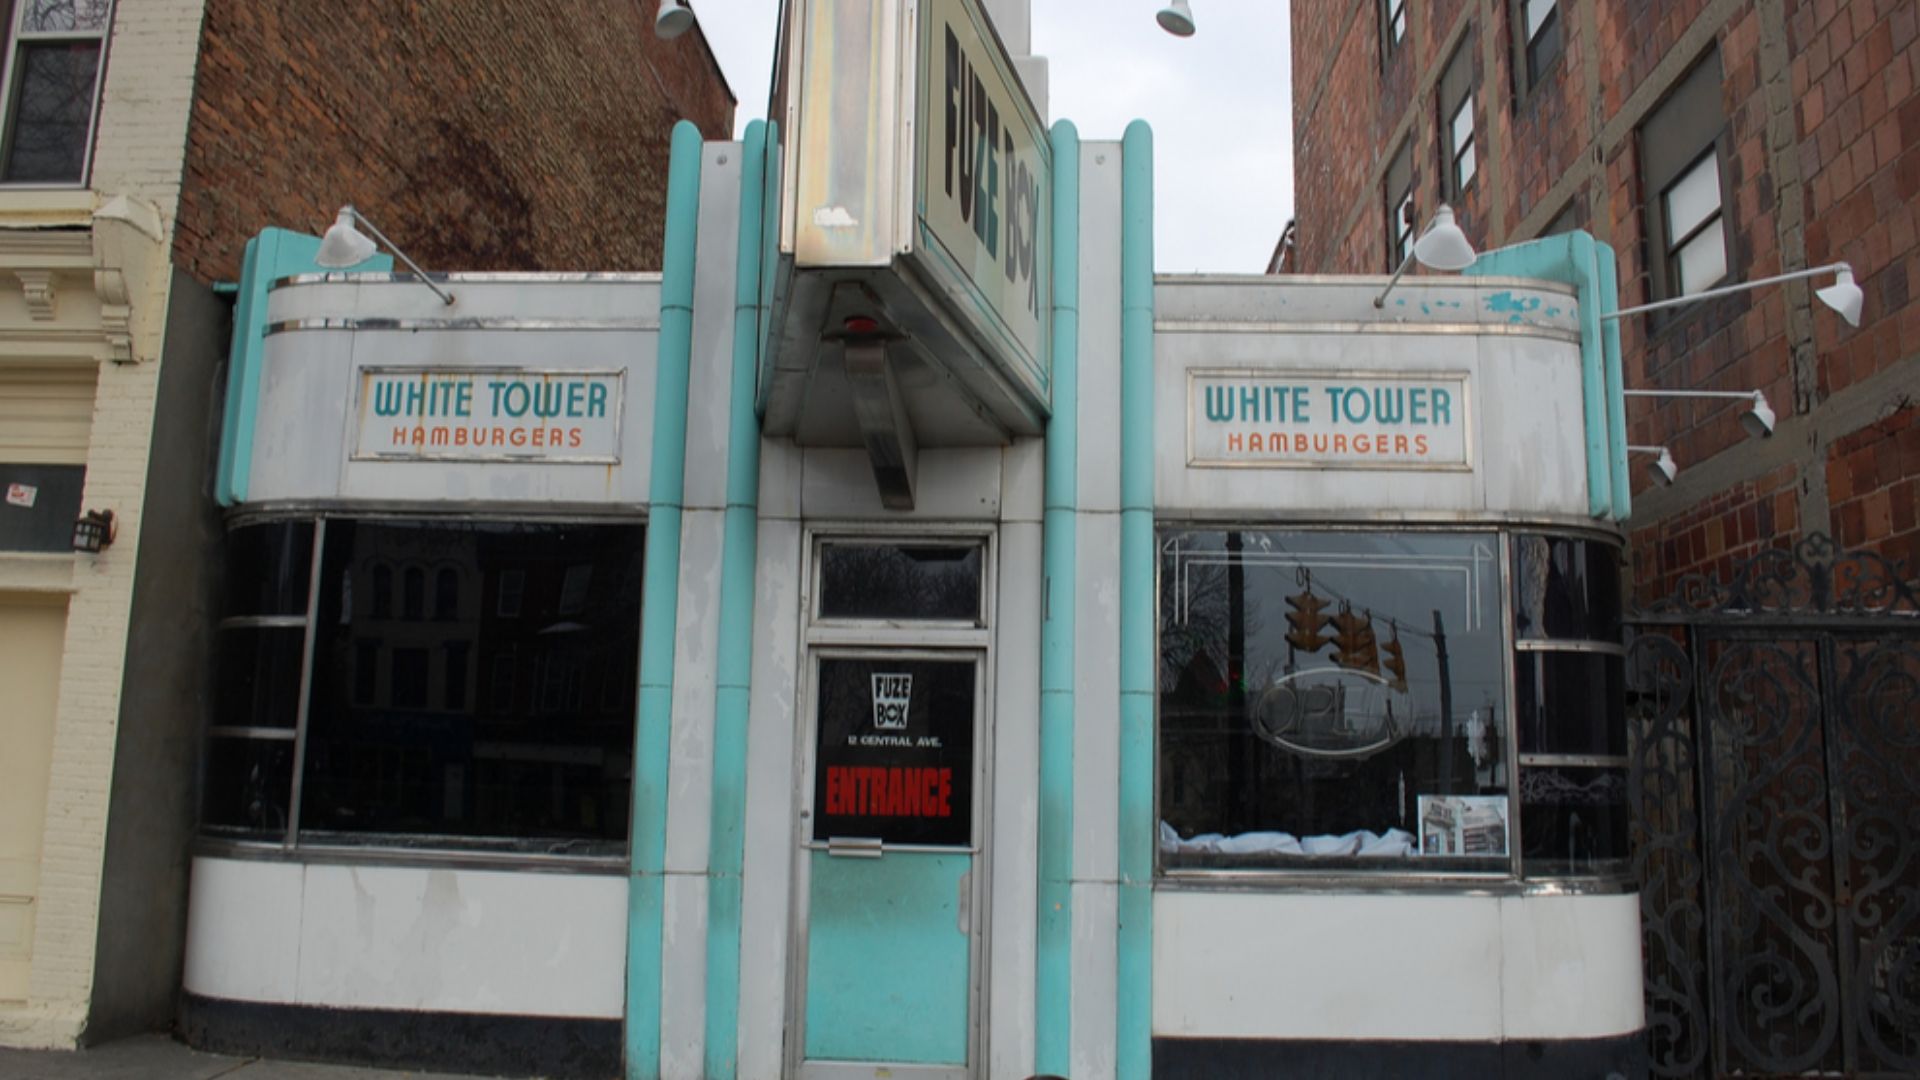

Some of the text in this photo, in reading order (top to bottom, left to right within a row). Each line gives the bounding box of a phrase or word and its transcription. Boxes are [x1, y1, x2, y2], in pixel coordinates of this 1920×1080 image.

[945, 20, 1039, 322] FUZE BOX
[374, 381, 607, 418] WHITE TOWER
[1205, 386, 1450, 425] WHITE TOWER
[393, 427, 581, 447] HAMBURGERS
[1228, 433, 1428, 455] HAMBURGERS
[875, 675, 909, 698] FUZE
[876, 702, 906, 726] BOX
[1257, 686, 1400, 737] OPE
[860, 736, 913, 746] CENTRAL
[916, 737, 942, 748] AVE.
[826, 766, 952, 817] ENTRANCE
